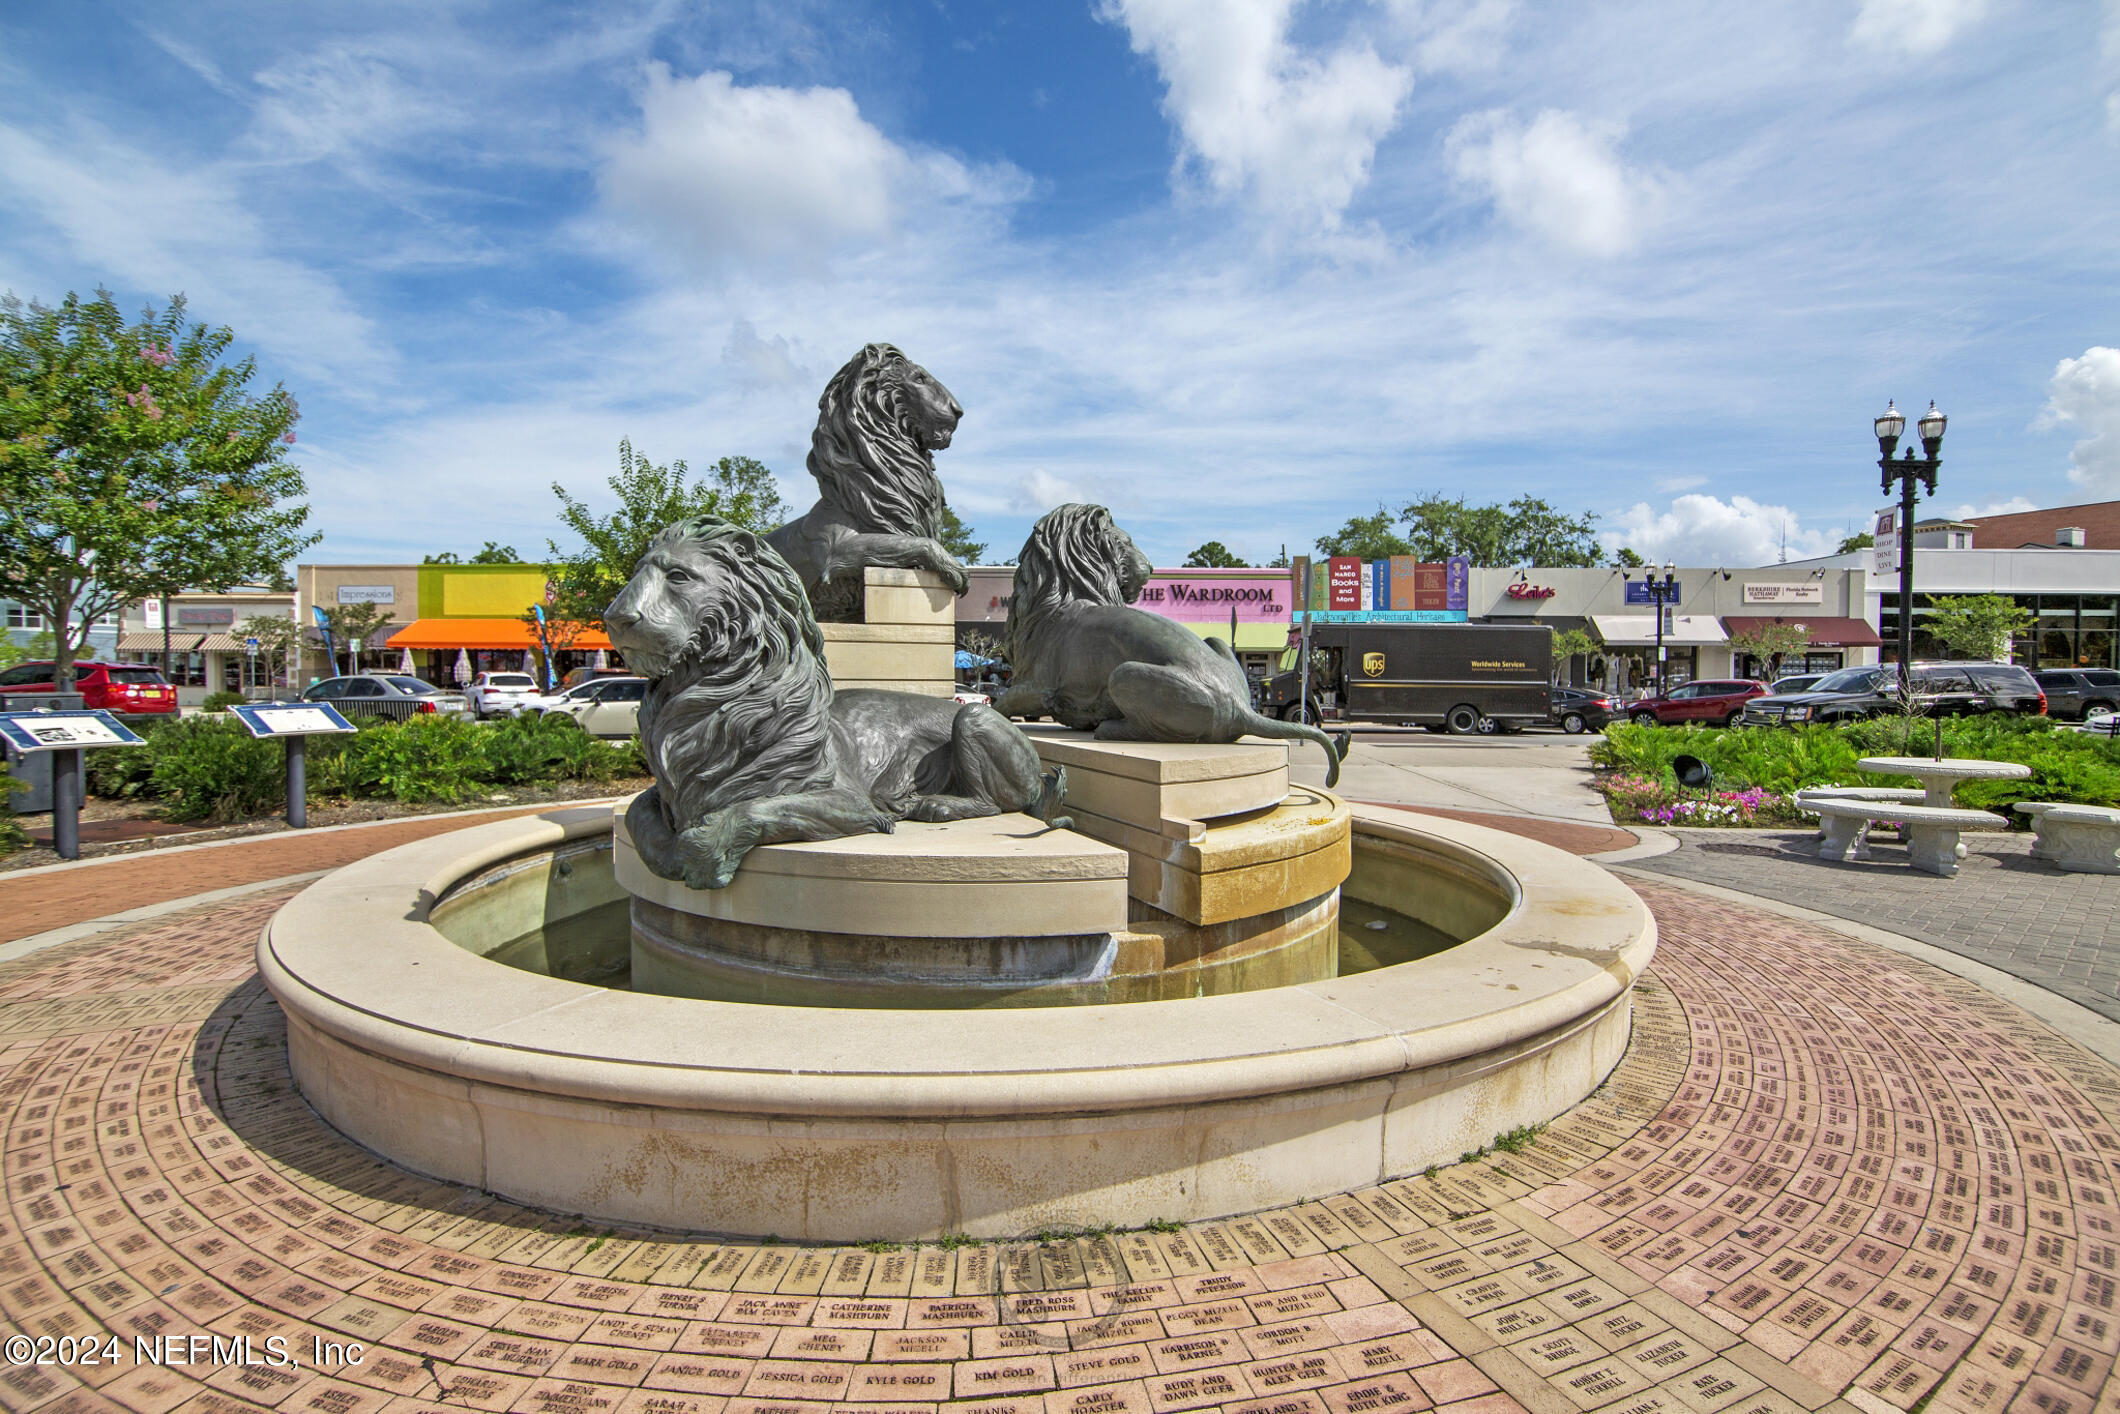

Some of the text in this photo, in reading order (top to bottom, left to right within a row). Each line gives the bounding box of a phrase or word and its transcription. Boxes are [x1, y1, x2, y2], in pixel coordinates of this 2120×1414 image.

[340, 589, 393, 601] Impressions
[1141, 585, 1273, 600] HE WARDROOM
[1365, 612, 1413, 621] Architectural
[1365, 659, 1384, 673] ups
[1599, 1227, 1628, 1243] WILLIAM
[1400, 1237, 1426, 1249] CASEY
[1480, 1246, 1501, 1256] MIKE
[1502, 1247, 1530, 1259] DAWES
[1424, 1258, 1463, 1274] CAMERON
[1703, 1251, 1731, 1268] MICHAEL
[1200, 1275, 1232, 1286] TRUDY
[1536, 1270, 1564, 1283] DAWES
[376, 1275, 435, 1296] SARAH CAROL
[574, 1282, 592, 1292] THE
[1100, 1286, 1165, 1299] THE KELLER
[1194, 1282, 1246, 1295] PETERSON
[1466, 1282, 1500, 1297] CRAVEN
[576, 1291, 610, 1300] FAMILY
[660, 1292, 696, 1303] HENRY
[1016, 1296, 1074, 1307] FRED ROSS
[1118, 1295, 1153, 1304] FAMILY
[1254, 1290, 1325, 1309] BOB AND REID
[1564, 1288, 1591, 1302] BRIAN
[658, 1300, 700, 1311] TURNER
[740, 1299, 801, 1309] JACK ANNE
[831, 1303, 892, 1312] CATHERINE
[929, 1303, 977, 1311] PATRICIA
[1016, 1304, 1076, 1314] MASHBURN
[1276, 1301, 1313, 1314] MIZELL
[1572, 1296, 1602, 1309] DAWES
[829, 1311, 890, 1320] MASHBURN
[921, 1310, 984, 1320] MASHBURN
[1166, 1305, 1241, 1322] PEGGY MIZELL
[1495, 1314, 1519, 1326] JOHN
[1798, 1305, 1831, 1328] JEWELERS
[598, 1319, 627, 1329] ANDY
[643, 1324, 681, 1335] SUSAN
[1075, 1317, 1153, 1334] JACK ROBIN
[1193, 1316, 1224, 1326] DEAN
[1603, 1314, 1631, 1330] FRITZ
[1849, 1315, 1873, 1340] ENGLISH
[418, 1323, 463, 1339] CAROLYN
[609, 1329, 655, 1341] CHENEY
[999, 1330, 1039, 1339] CALLIE
[1256, 1328, 1298, 1340] GORDON
[1609, 1321, 1646, 1338] TUCKER
[813, 1334, 836, 1343] MEG
[896, 1336, 947, 1345] JACKSON
[1276, 1335, 1305, 1346] MOTT
[1542, 1337, 1572, 1351] SCOTT
[1856, 1328, 1881, 1347] FAMILY
[524, 1347, 552, 1355] NAN
[798, 1342, 845, 1352] CHENEY
[1160, 1340, 1217, 1354] HARRISON
[1361, 1345, 1391, 1358] MARY
[1543, 1346, 1580, 1361] BRIDGE
[1635, 1340, 1684, 1363] ELIZABETH
[1178, 1350, 1223, 1361] BARNES
[1364, 1353, 1404, 1368] MIZELL
[1652, 1351, 1690, 1368] TUCKER
[570, 1355, 639, 1371] MARK GOLD
[1068, 1355, 1141, 1372] STEVE GOLD
[1252, 1358, 1326, 1378] HUNTER AND
[659, 1364, 741, 1379] JANICE GOLD
[757, 1372, 844, 1385] JESSICA GOLD
[975, 1367, 1035, 1381] KIM GOLD
[1264, 1368, 1328, 1386] ALEX GEER
[1869, 1358, 1914, 1393] DALE FERRELL
[235, 1373, 275, 1391] FAMILY
[452, 1375, 497, 1389] EDWARD
[866, 1376, 936, 1385] KYLE GOLD
[1164, 1375, 1226, 1391] RUDY AND
[1568, 1371, 1607, 1389] ROBERT
[1584, 1378, 1627, 1396] FERRELL
[1692, 1374, 1719, 1389] KATE
[1893, 1372, 1920, 1393] LINDER
[562, 1384, 598, 1395] IRENE
[1164, 1384, 1236, 1401] DAWN GEER
[1347, 1387, 1381, 1401] EDDIE
[1699, 1380, 1738, 1399] TUCKER
[321, 1388, 361, 1406] ASHLEY
[1076, 1392, 1114, 1405] CARLY
[1347, 1393, 1410, 1413] RUTH KING
[645, 1399, 687, 1410] SARAH
